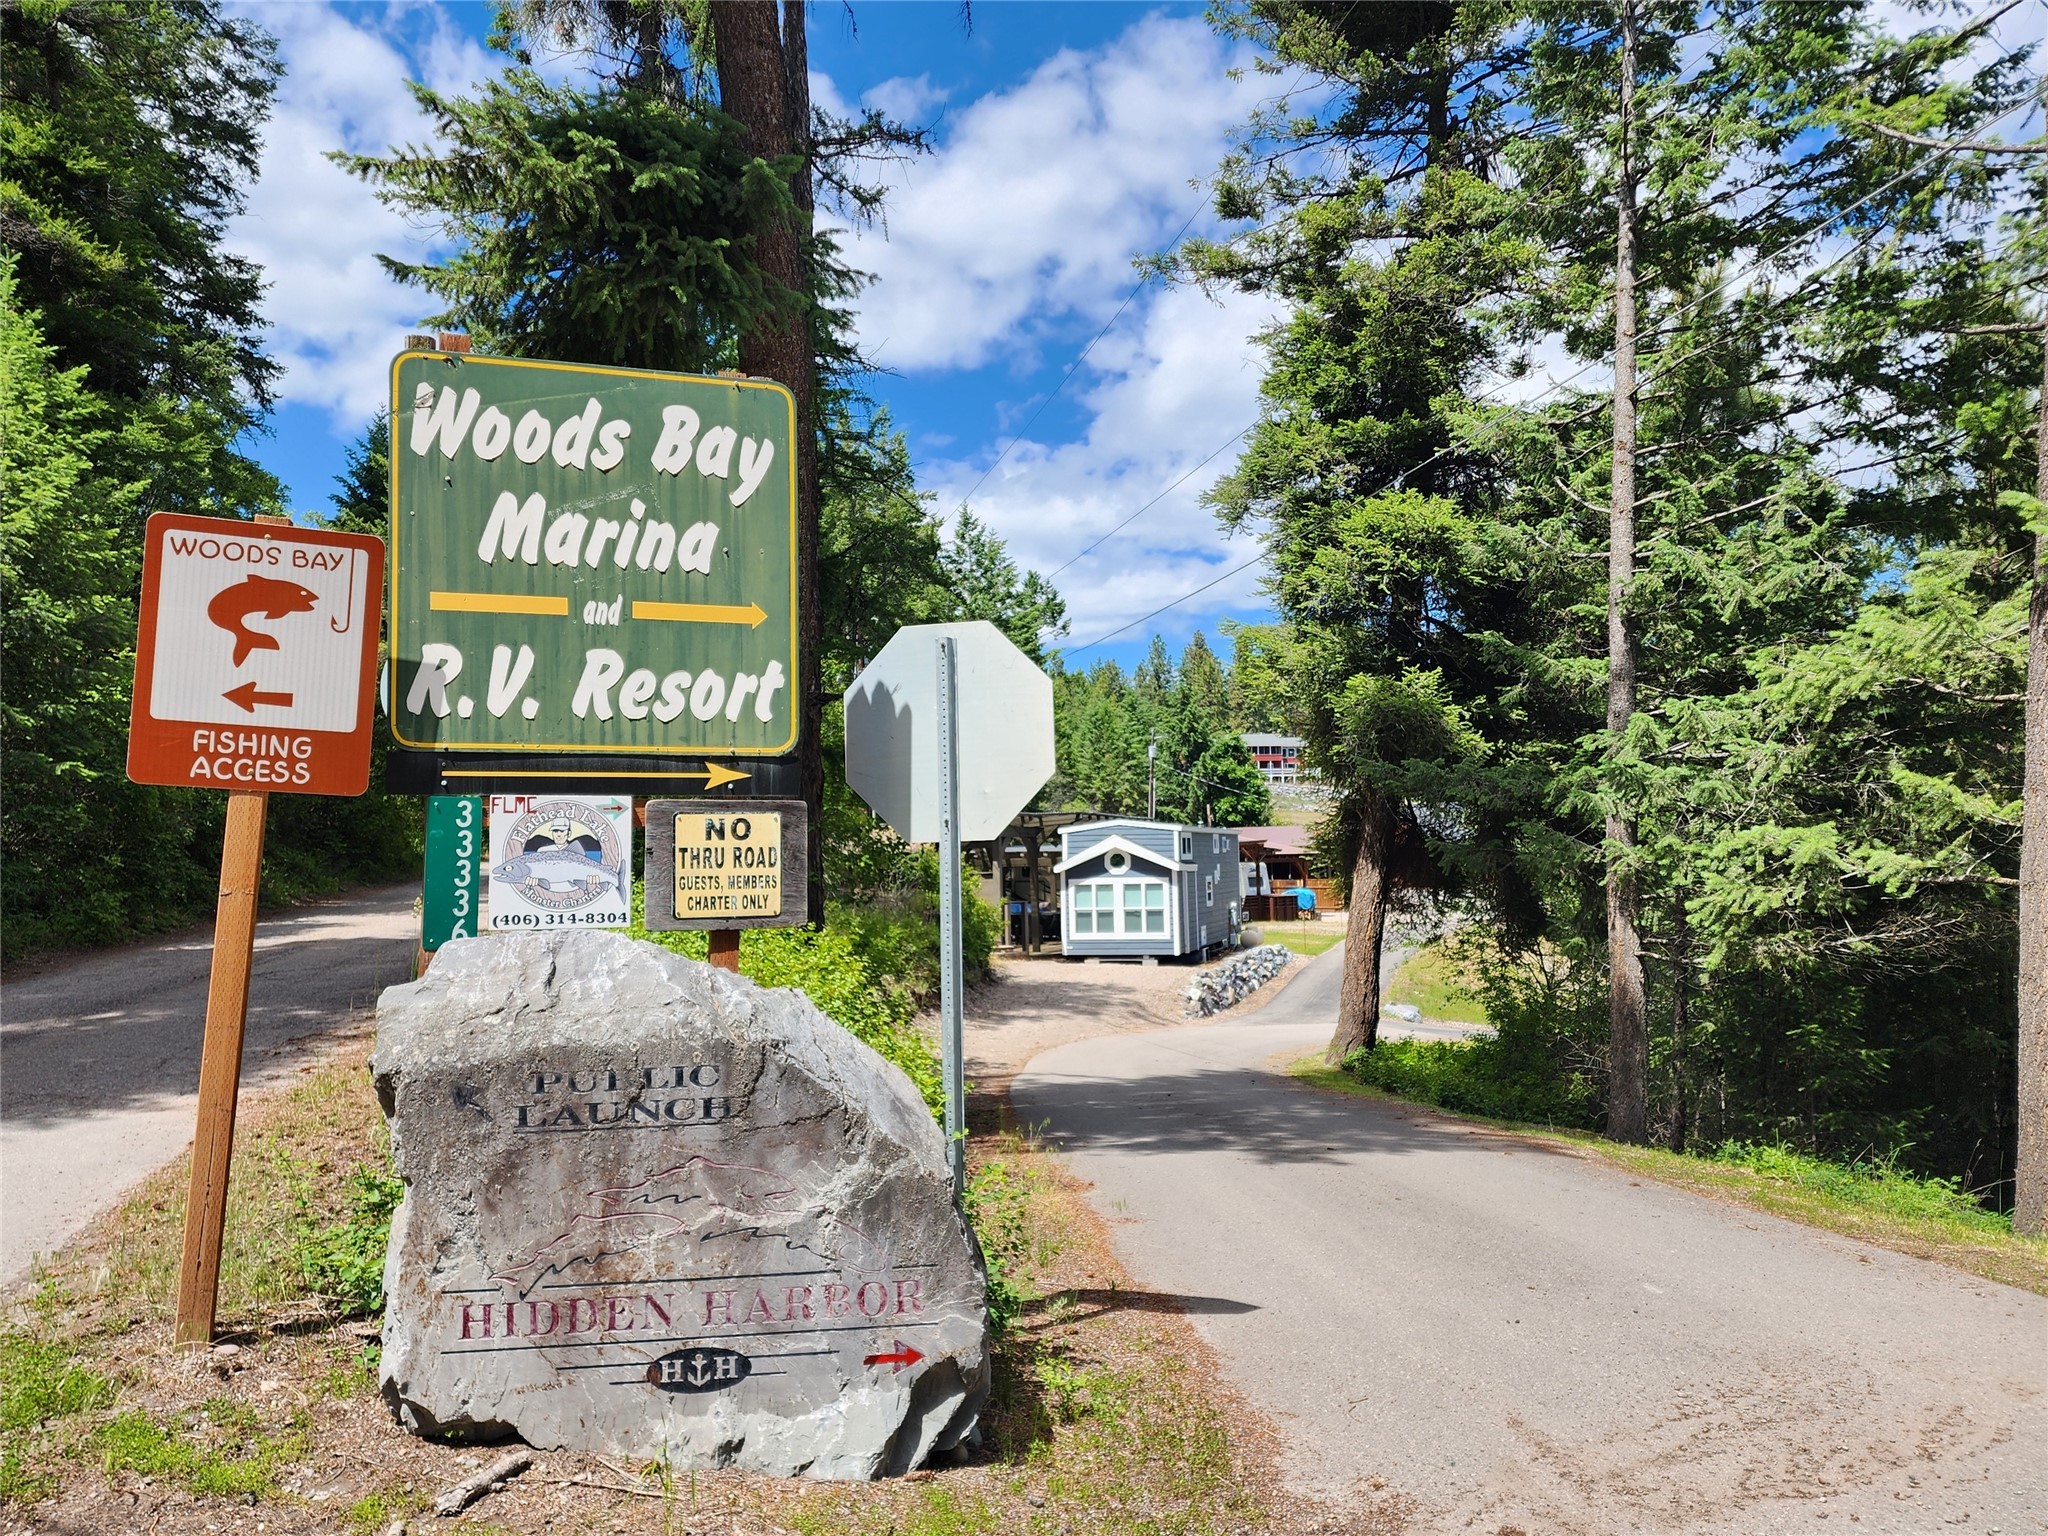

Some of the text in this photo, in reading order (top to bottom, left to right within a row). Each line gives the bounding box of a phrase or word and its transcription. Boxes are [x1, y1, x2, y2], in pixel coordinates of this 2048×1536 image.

[410, 381, 776, 507] Woods Bay
[478, 490, 720, 575] Marina
[170, 536, 344, 572] WOODS BAY
[583, 593, 623, 626] and
[406, 643, 785, 723] R.V. Resort
[193, 729, 312, 759] FISHING
[190, 756, 311, 785] ACCESS
[511, 805, 610, 844] Flathead Lake
[705, 817, 752, 841] NO
[678, 846, 778, 869] THRU ROAD
[521, 885, 560, 908] Monster
[679, 875, 777, 893] GUESTS, MEMBERS
[687, 894, 769, 911] CHARTER ONLY
[492, 912, 628, 928] (406) 314-8304
[514, 1097, 732, 1129] LAUNCH
[458, 1280, 927, 1341] HIDDEN HARBOR
